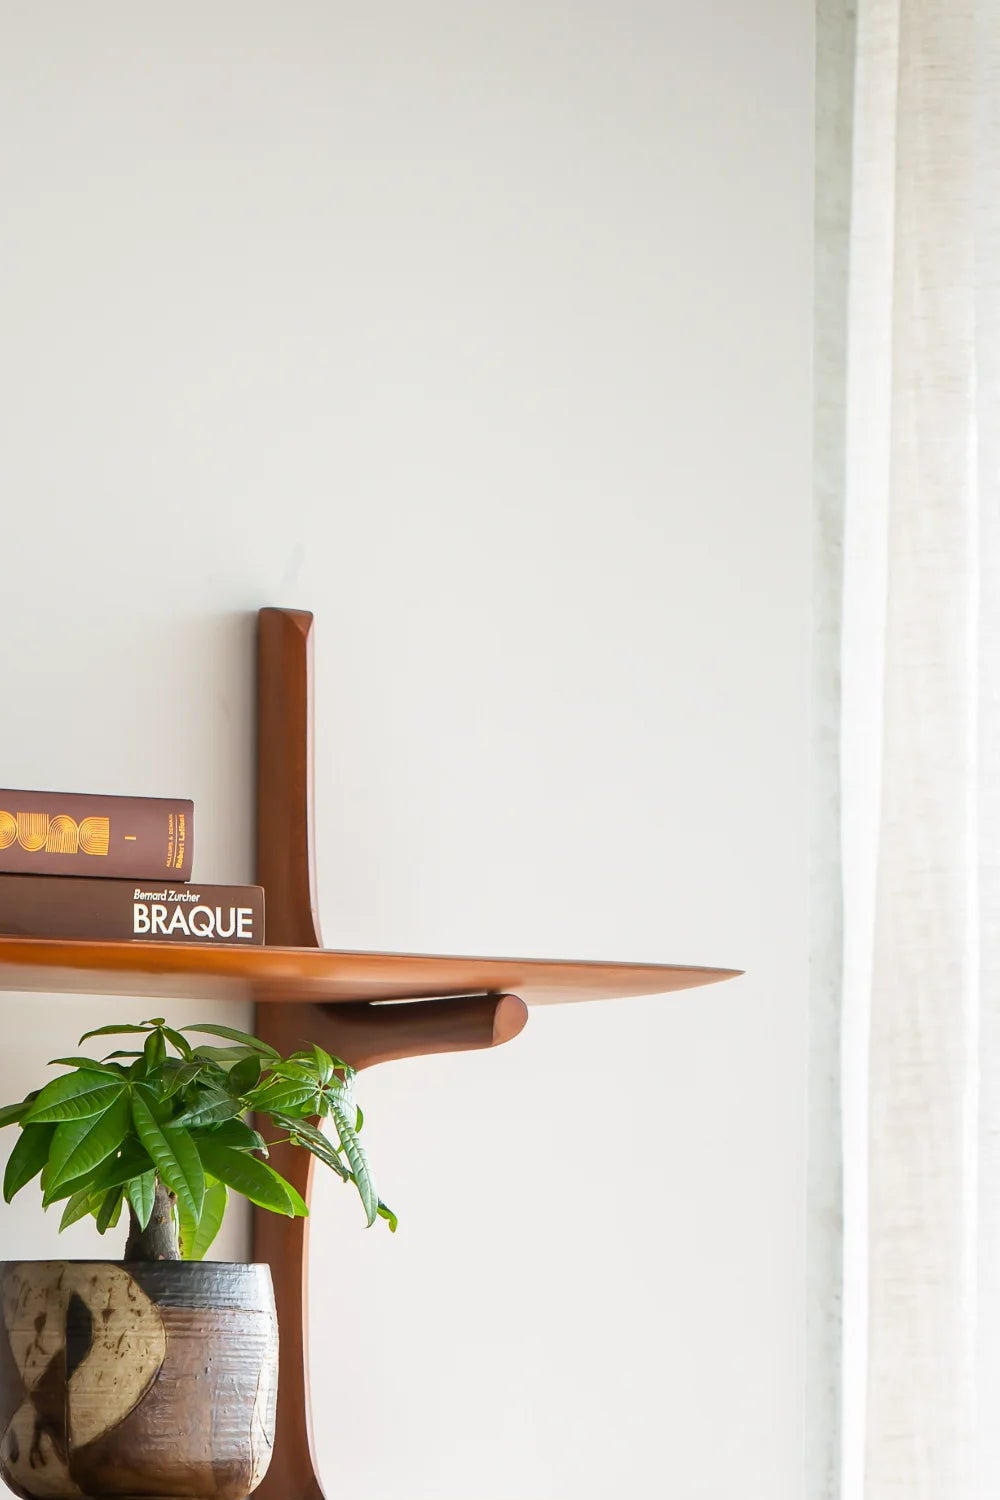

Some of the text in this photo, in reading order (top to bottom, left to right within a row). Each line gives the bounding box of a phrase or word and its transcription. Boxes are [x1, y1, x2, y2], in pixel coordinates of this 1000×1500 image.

[175, 843, 185, 869] Robert
[133, 888, 201, 903] Bernard Zurcher
[133, 903, 253, 938] BRAQUE
